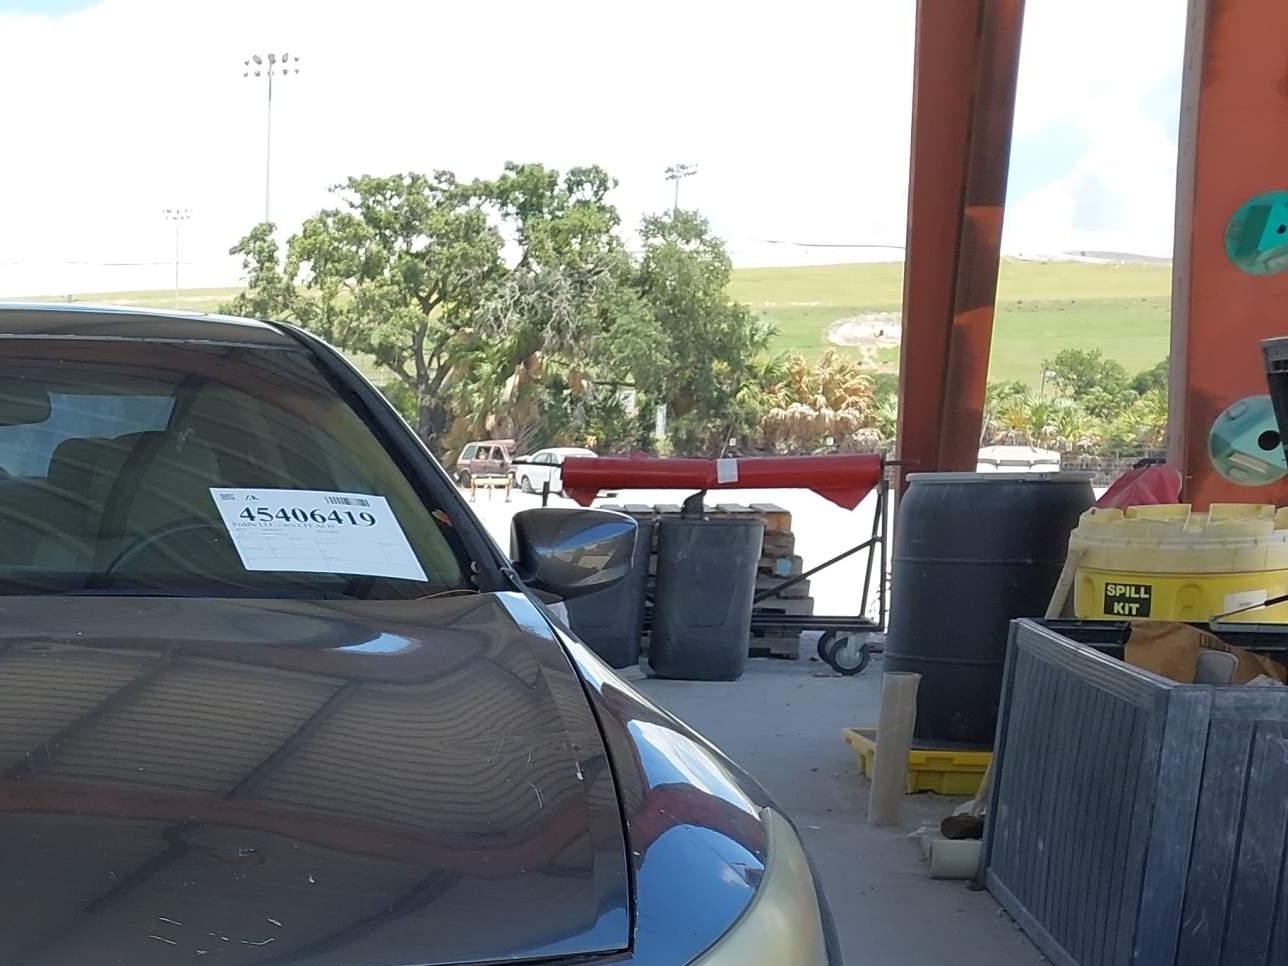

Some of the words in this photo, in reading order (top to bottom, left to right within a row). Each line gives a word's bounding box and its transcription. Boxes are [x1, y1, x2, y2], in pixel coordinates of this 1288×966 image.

[239, 506, 376, 528] 45406419
[1106, 584, 1150, 599] SPILL
[1113, 602, 1140, 616] KIT
